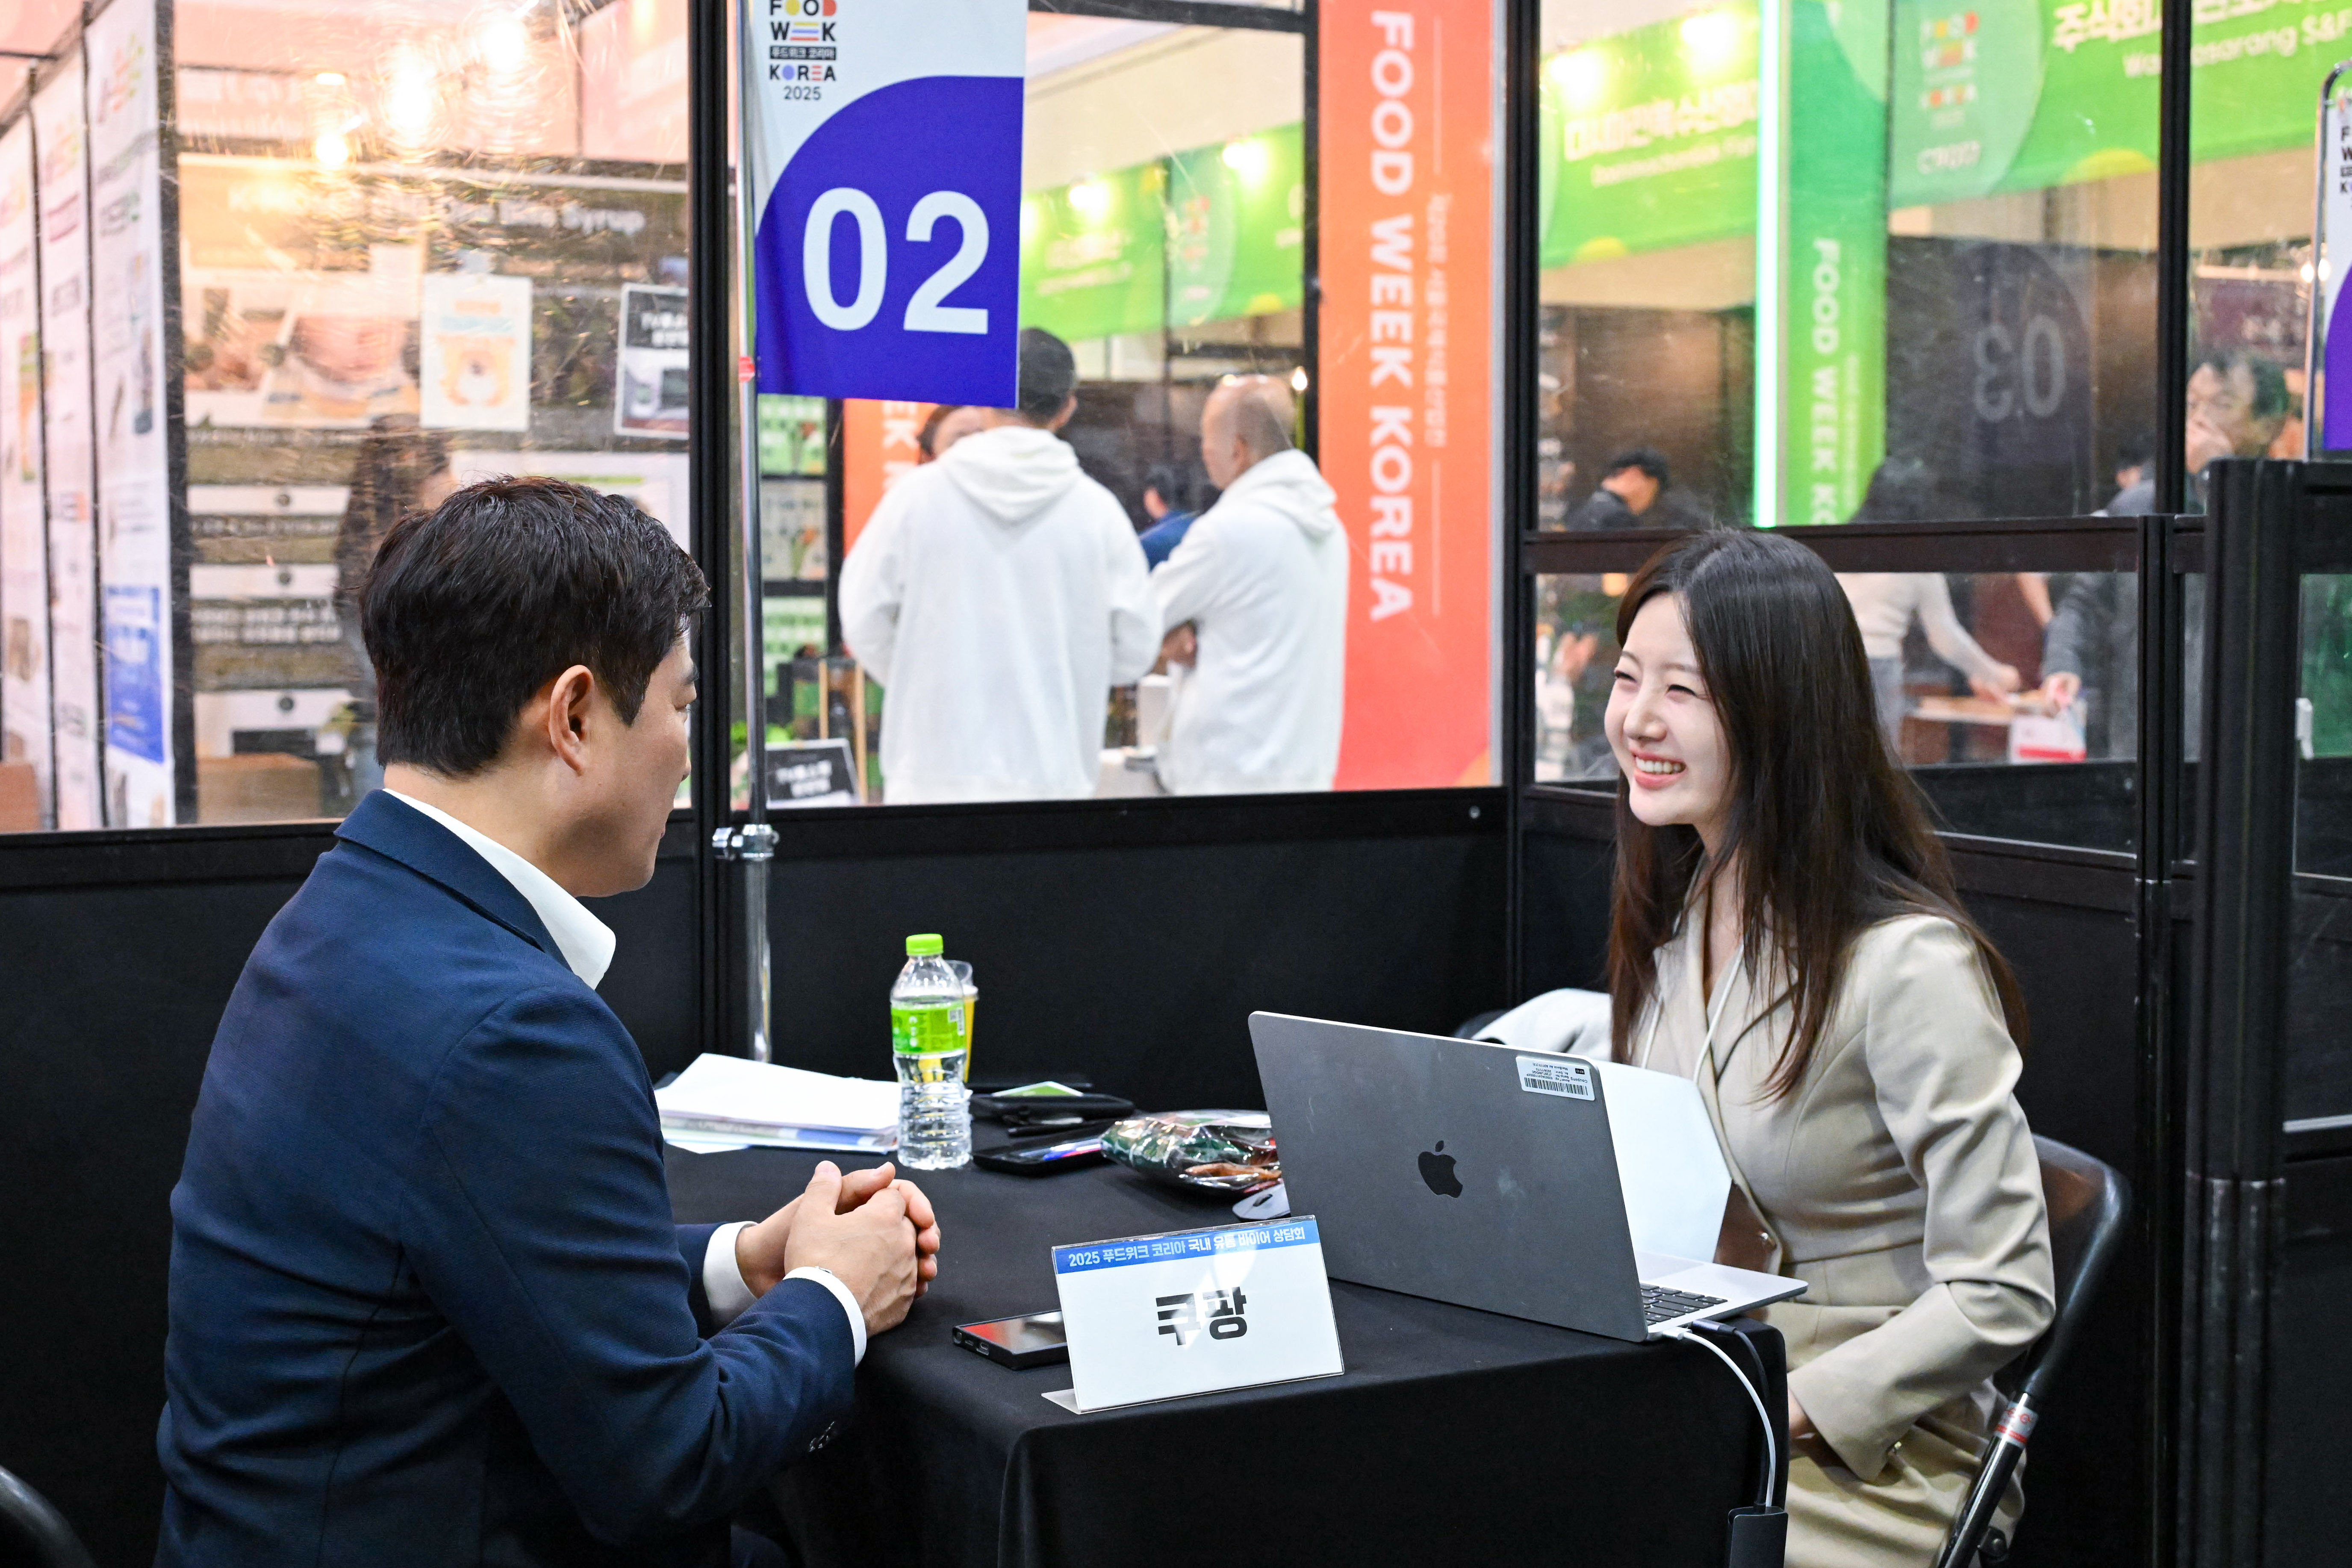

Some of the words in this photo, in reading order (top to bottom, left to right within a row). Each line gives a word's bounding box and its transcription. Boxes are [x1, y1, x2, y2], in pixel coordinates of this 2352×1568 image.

[770, 64, 836, 81] KOREA
[784, 86, 821, 100] 2025
[1371, 10, 1414, 195] FOOD
[803, 187, 989, 334] 02
[1371, 214, 1414, 389] WEEK
[1812, 238, 1841, 354] FOOD
[1811, 365, 1839, 472] WEEK
[1370, 406, 1413, 622] KOREA
[1069, 1251, 1100, 1267] 2025
[1102, 1245, 1149, 1262] 푸드위크
[1152, 1241, 1185, 1256] 코리아
[1188, 1237, 1211, 1252] 국내
[1213, 1235, 1237, 1250] 유통
[1239, 1230, 1271, 1246] 바이어
[1273, 1226, 1306, 1243] 상담회
[1155, 1286, 1247, 1346] 쿠팡
